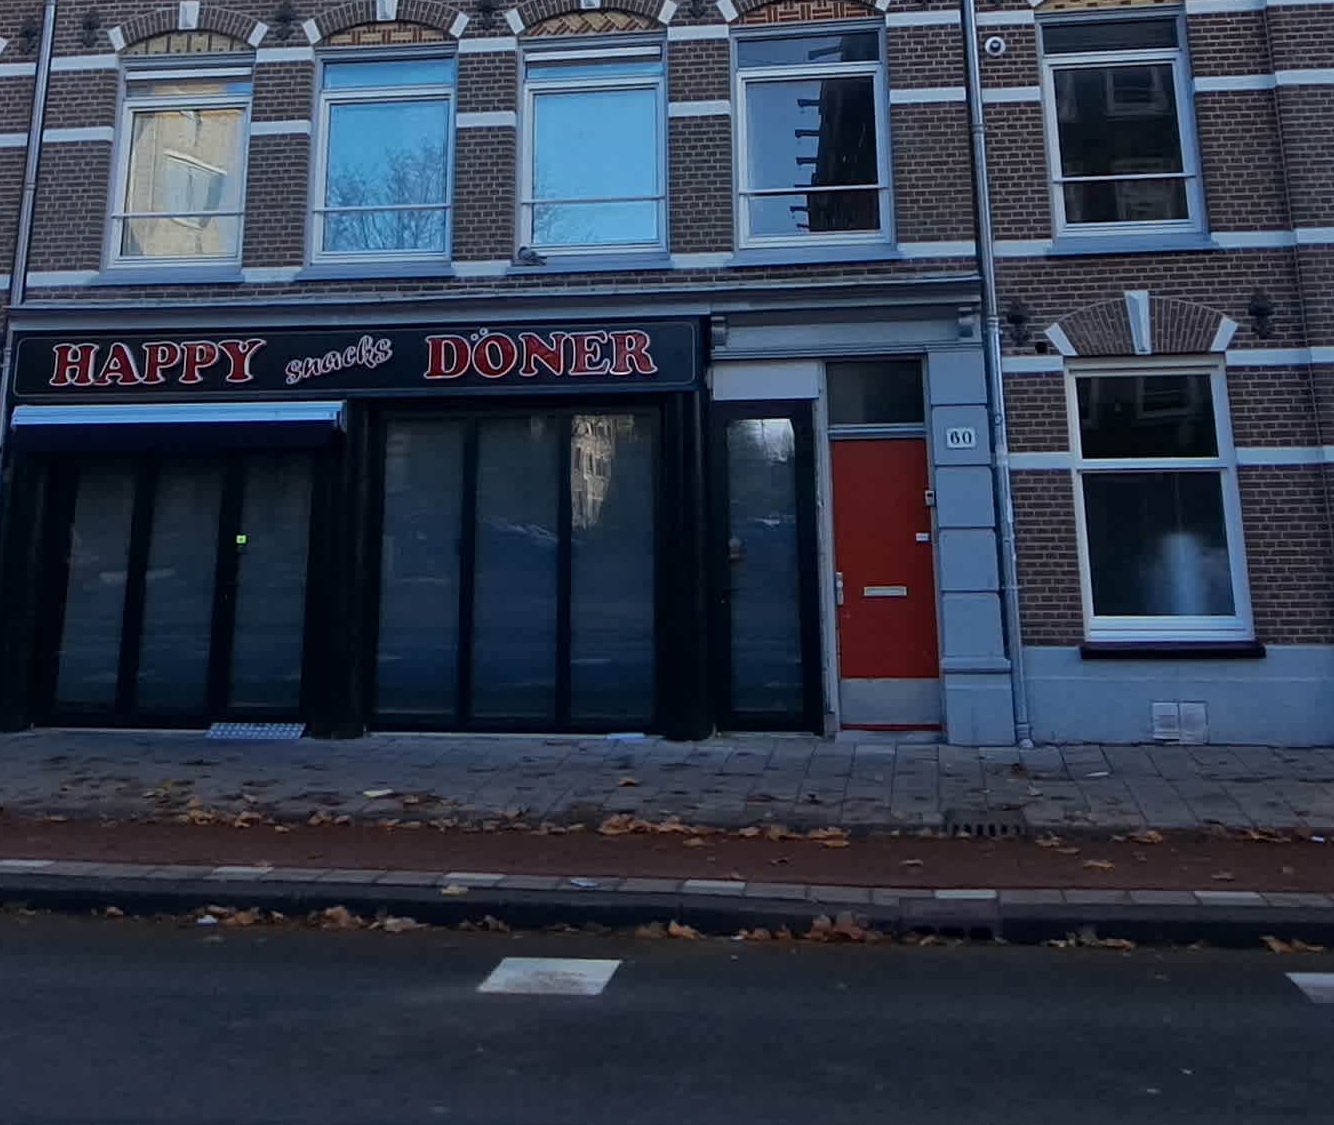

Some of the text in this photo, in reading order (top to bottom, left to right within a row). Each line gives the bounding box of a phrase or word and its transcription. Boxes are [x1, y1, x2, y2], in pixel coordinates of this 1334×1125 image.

[49, 328, 659, 387] HAPPY snacks DÖNER
[949, 430, 972, 445] 60
